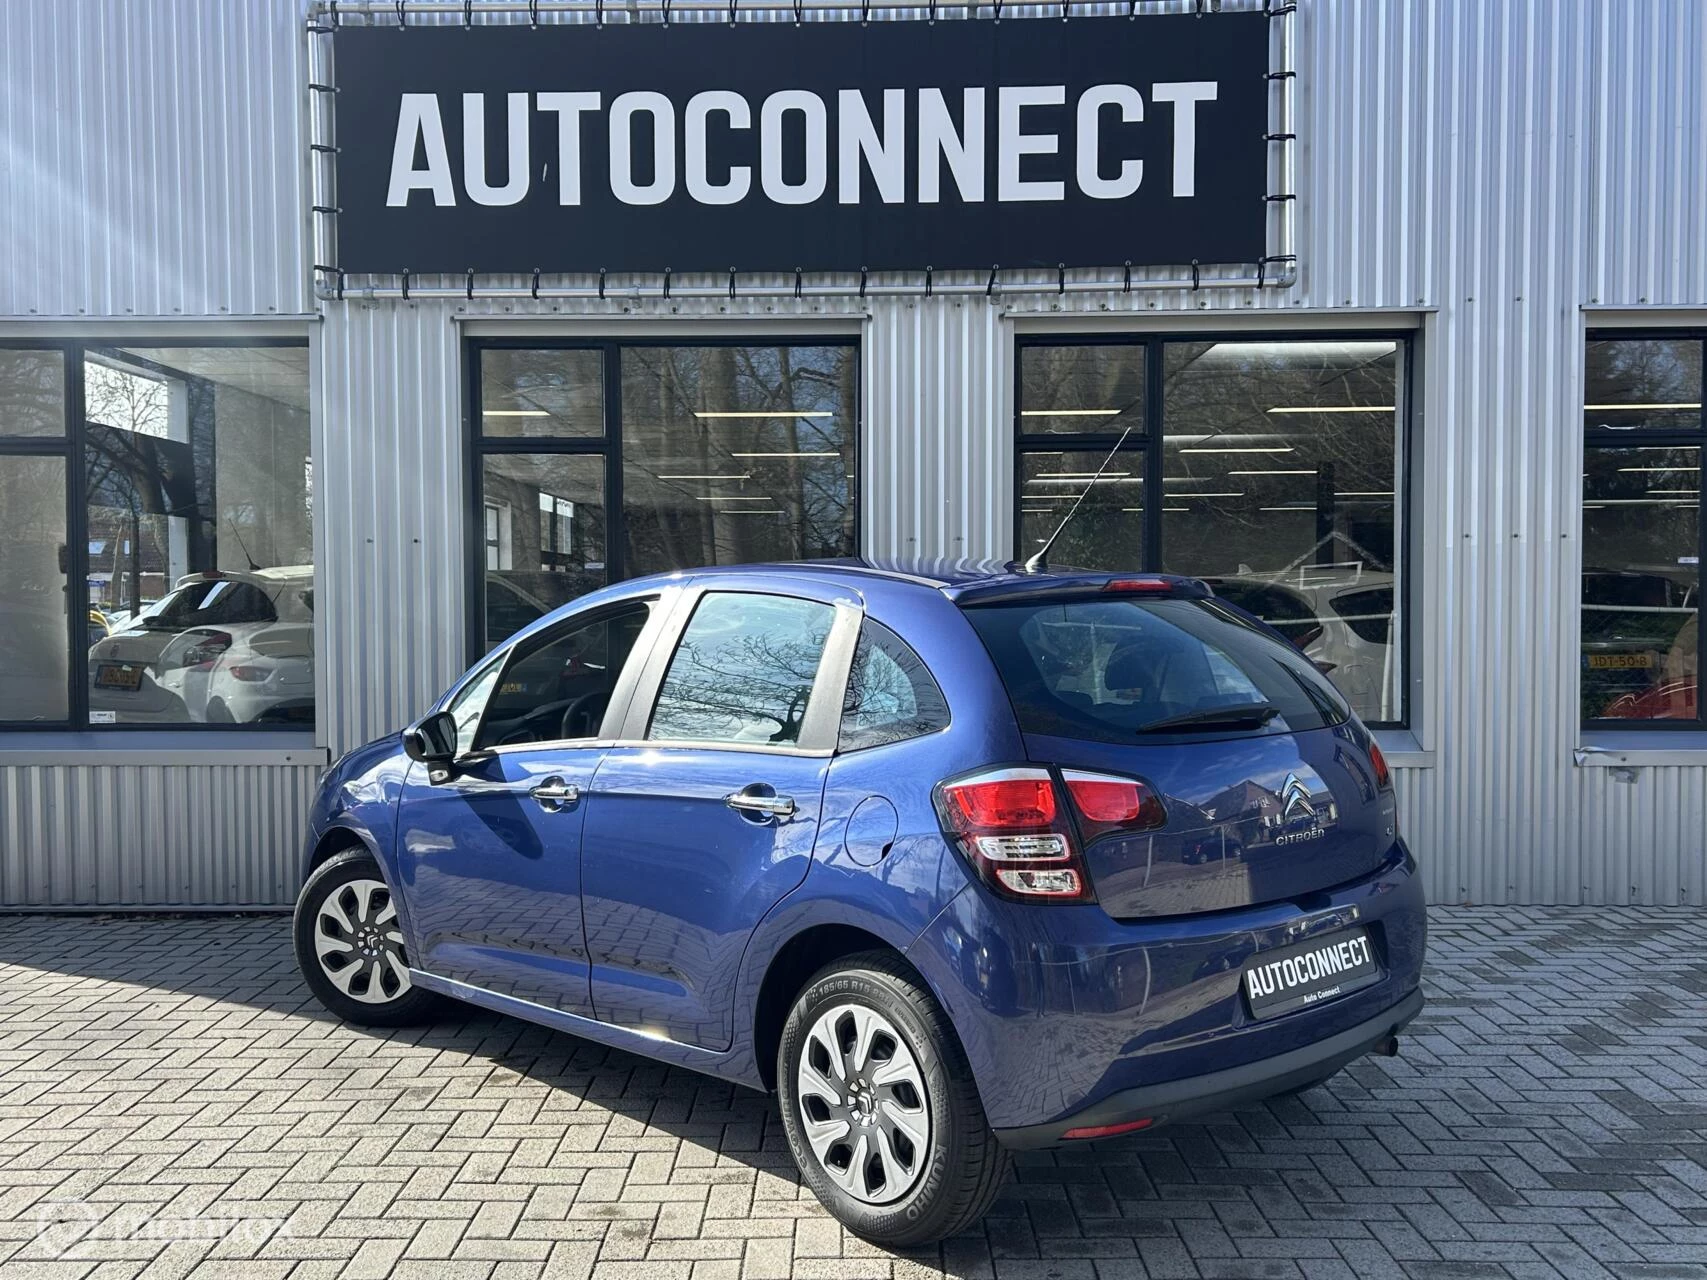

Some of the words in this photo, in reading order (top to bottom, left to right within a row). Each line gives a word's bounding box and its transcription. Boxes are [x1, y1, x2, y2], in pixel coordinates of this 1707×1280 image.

[385, 81, 1218, 207] AUTOCONNECT
[1247, 936, 1371, 999] AUTOCONNECT
[1303, 993, 1318, 1003] Auto
[1317, 986, 1340, 999] Connect
[905, 1143, 947, 1221] KUMHO
